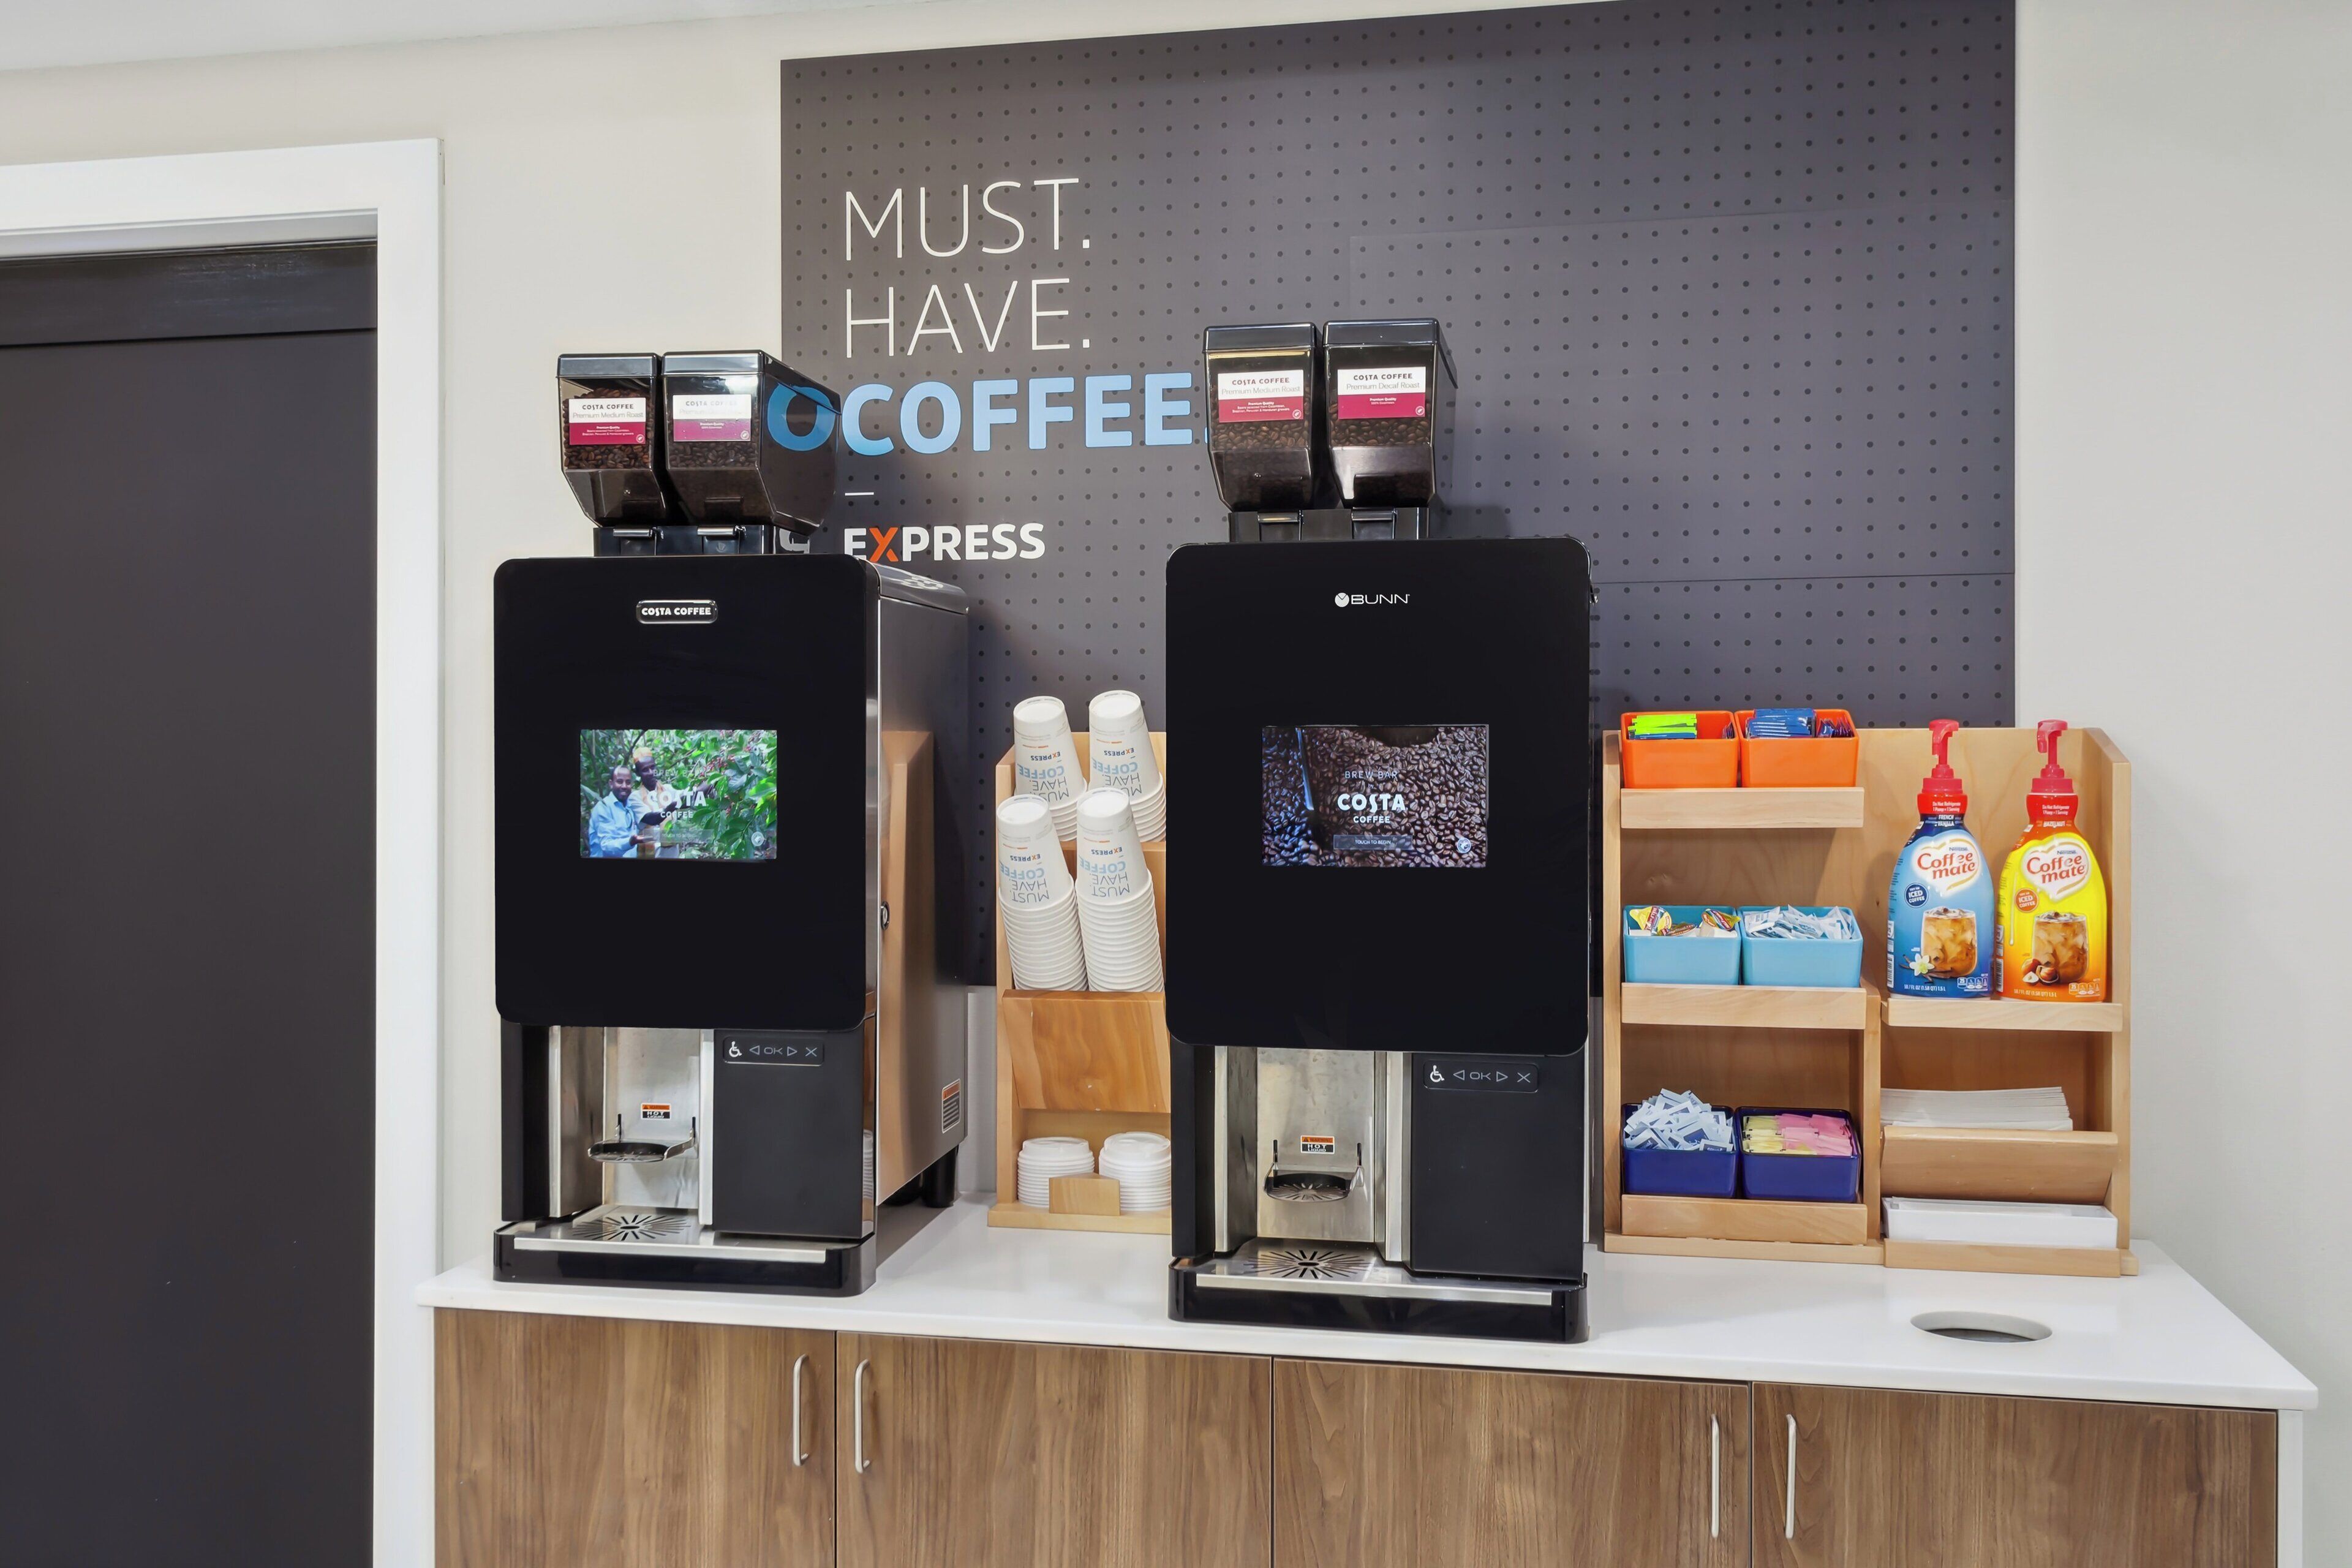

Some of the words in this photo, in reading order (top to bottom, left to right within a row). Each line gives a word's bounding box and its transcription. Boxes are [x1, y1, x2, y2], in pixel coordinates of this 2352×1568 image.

[846, 178, 1090, 261] MUST.
[846, 278, 1090, 358] HAVE.
[842, 372, 1207, 456] COFFEE
[844, 522, 1046, 562] EXPRESS
[1351, 594, 1409, 605] BUNN
[641, 608, 672, 616] COSTA
[1030, 752, 1060, 761] EXPRESS
[1104, 748, 1134, 756] EXPRESS
[1029, 777, 1067, 791] HAVE.
[1102, 772, 1140, 786] HAVE.
[1338, 793, 1406, 813] COSTA
[1091, 846, 1122, 855] EXPRESS
[1917, 853, 1973, 870] Coffee
[2027, 856, 2082, 874] Coffee
[1932, 862, 1975, 879] mate
[2041, 865, 2085, 883] mate
[1009, 878, 1047, 891] HAVE.
[1090, 872, 1128, 885] HAVE.
[1010, 890, 1049, 903] MUST.
[1090, 883, 1130, 897] MUST.
